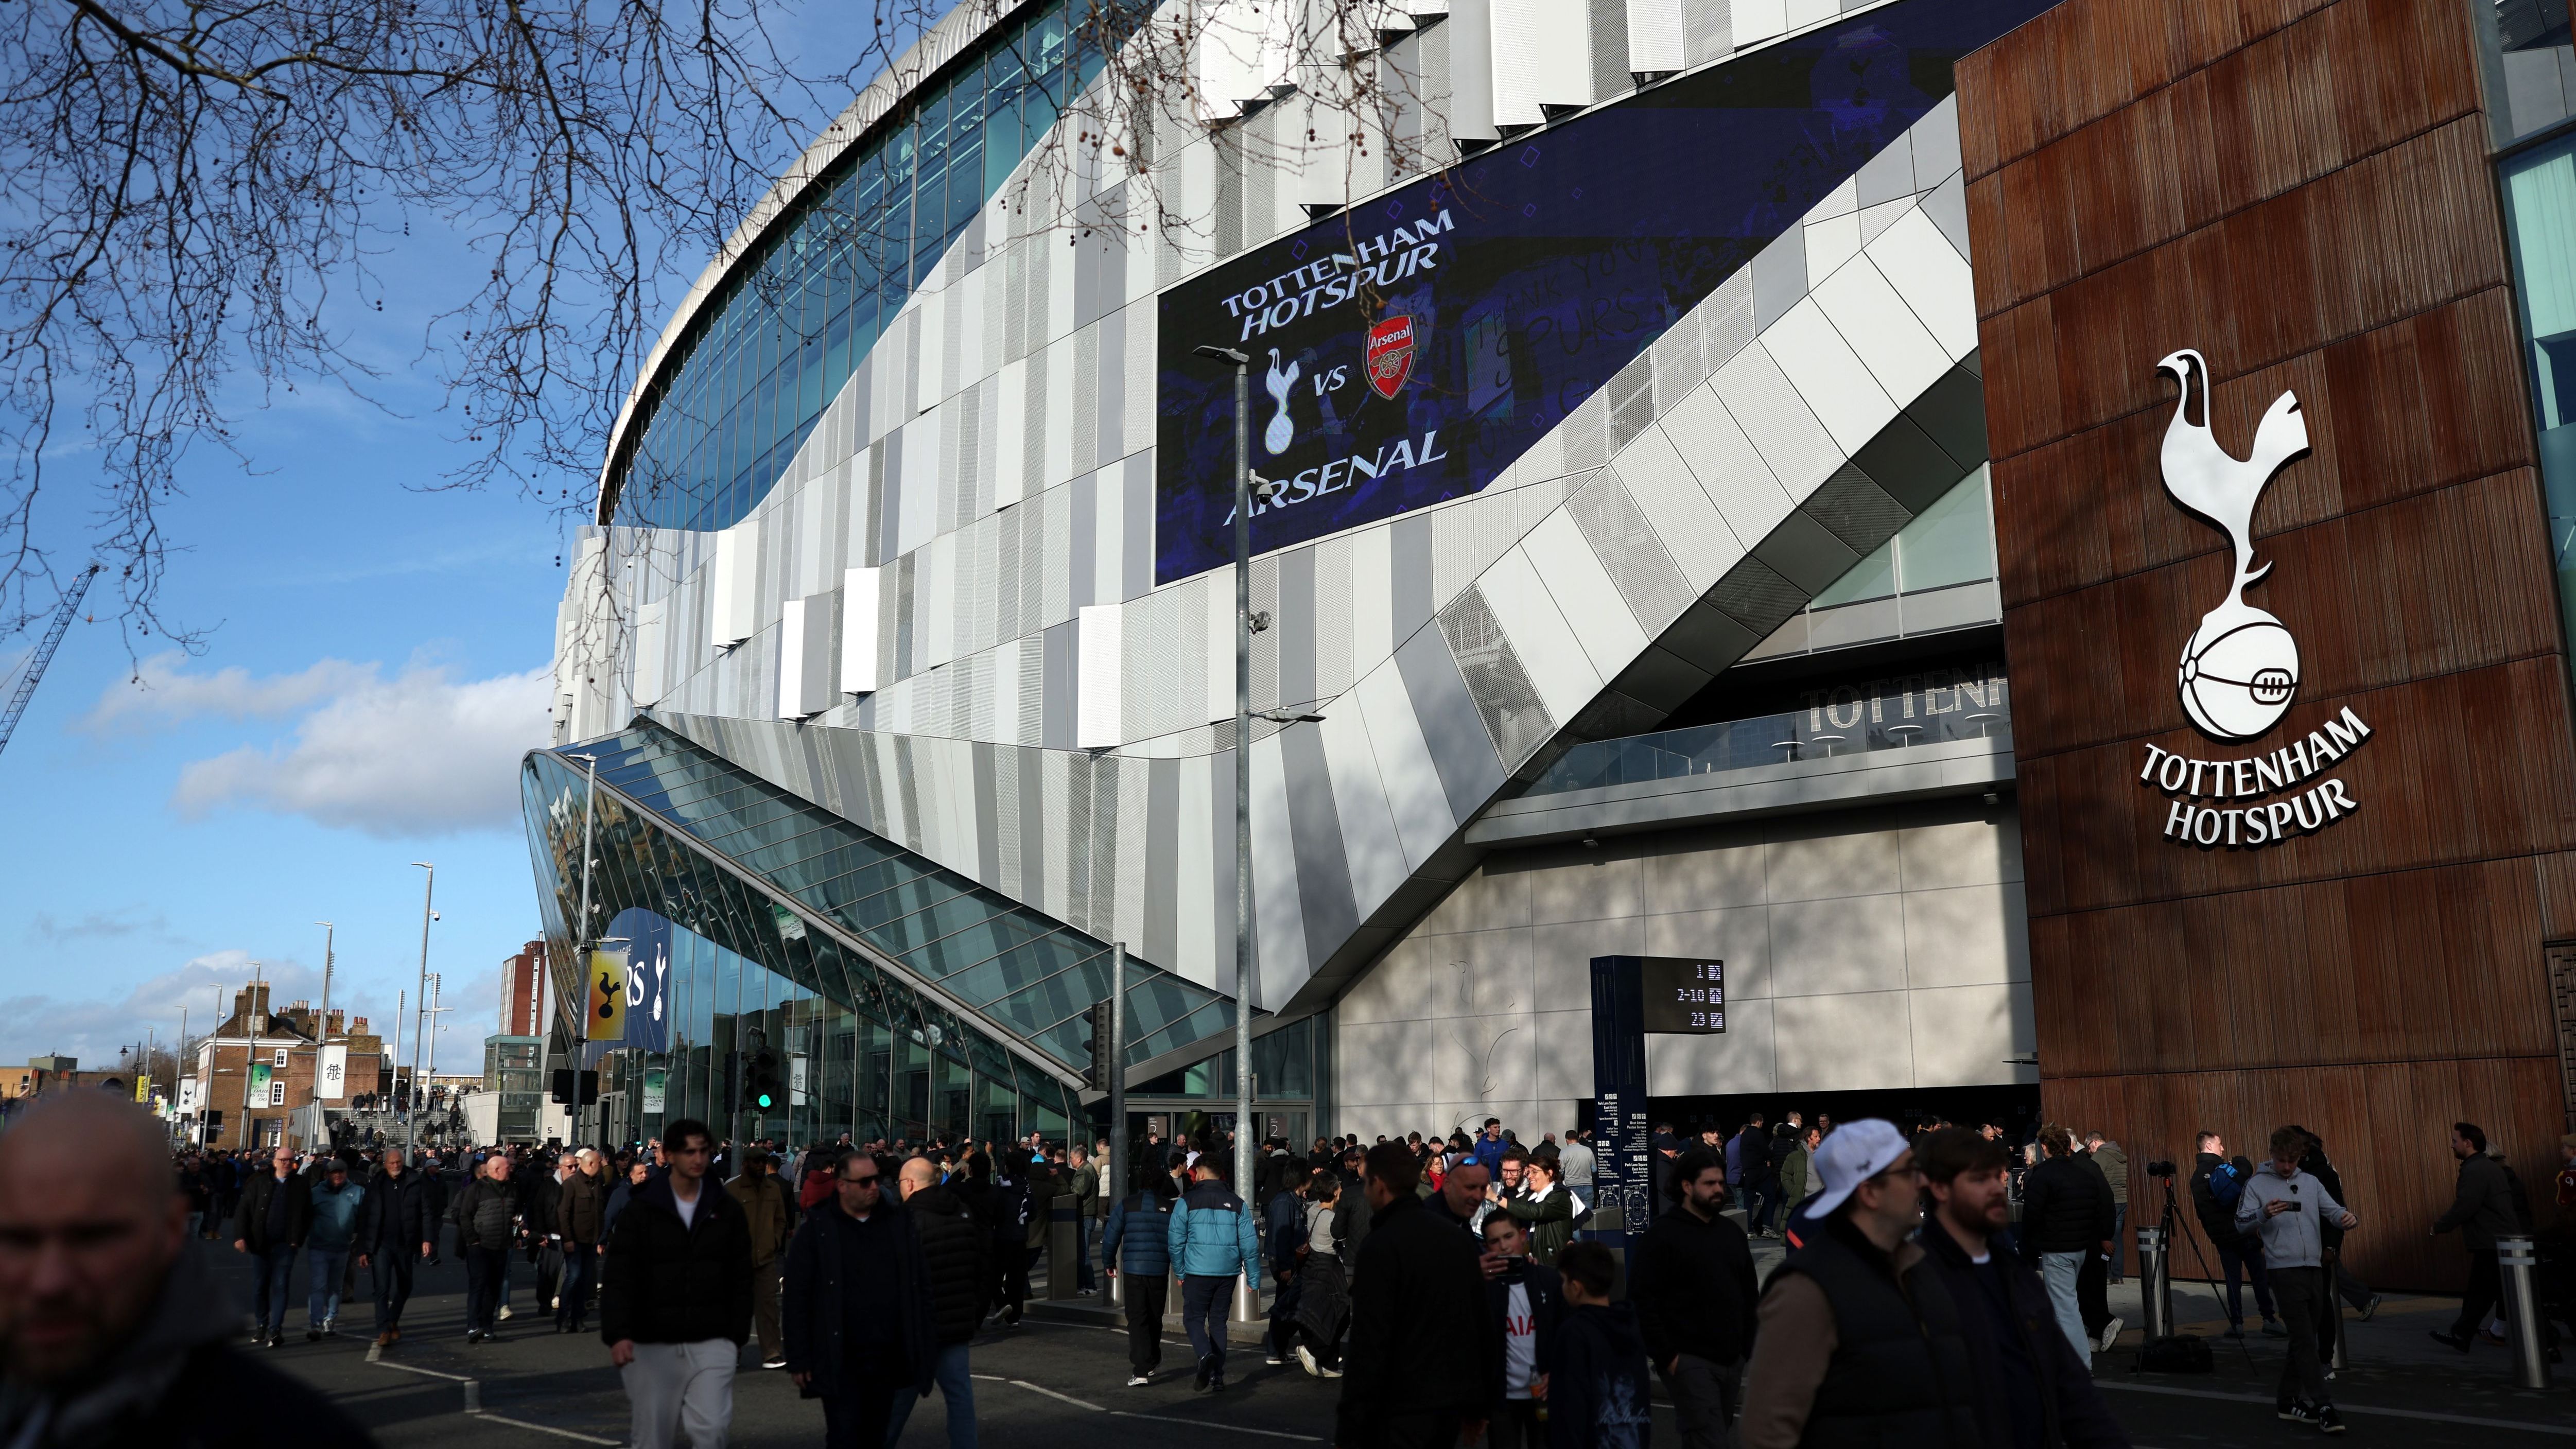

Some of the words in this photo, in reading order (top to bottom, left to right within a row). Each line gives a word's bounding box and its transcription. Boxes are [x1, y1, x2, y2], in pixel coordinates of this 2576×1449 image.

[1222, 208, 1455, 318] TOTTENHAM
[1240, 242, 1438, 342] HOTSPUR
[1369, 325, 1411, 350] Arsenal
[2140, 706, 2371, 797] TOTTENHAM
[2164, 779, 2357, 845] HOTSPUR
[1696, 965, 1703, 978] 1
[1677, 988, 1704, 1002] 2-10
[1691, 1012, 1705, 1026] 23
[1270, 1125, 1278, 1137] 2
